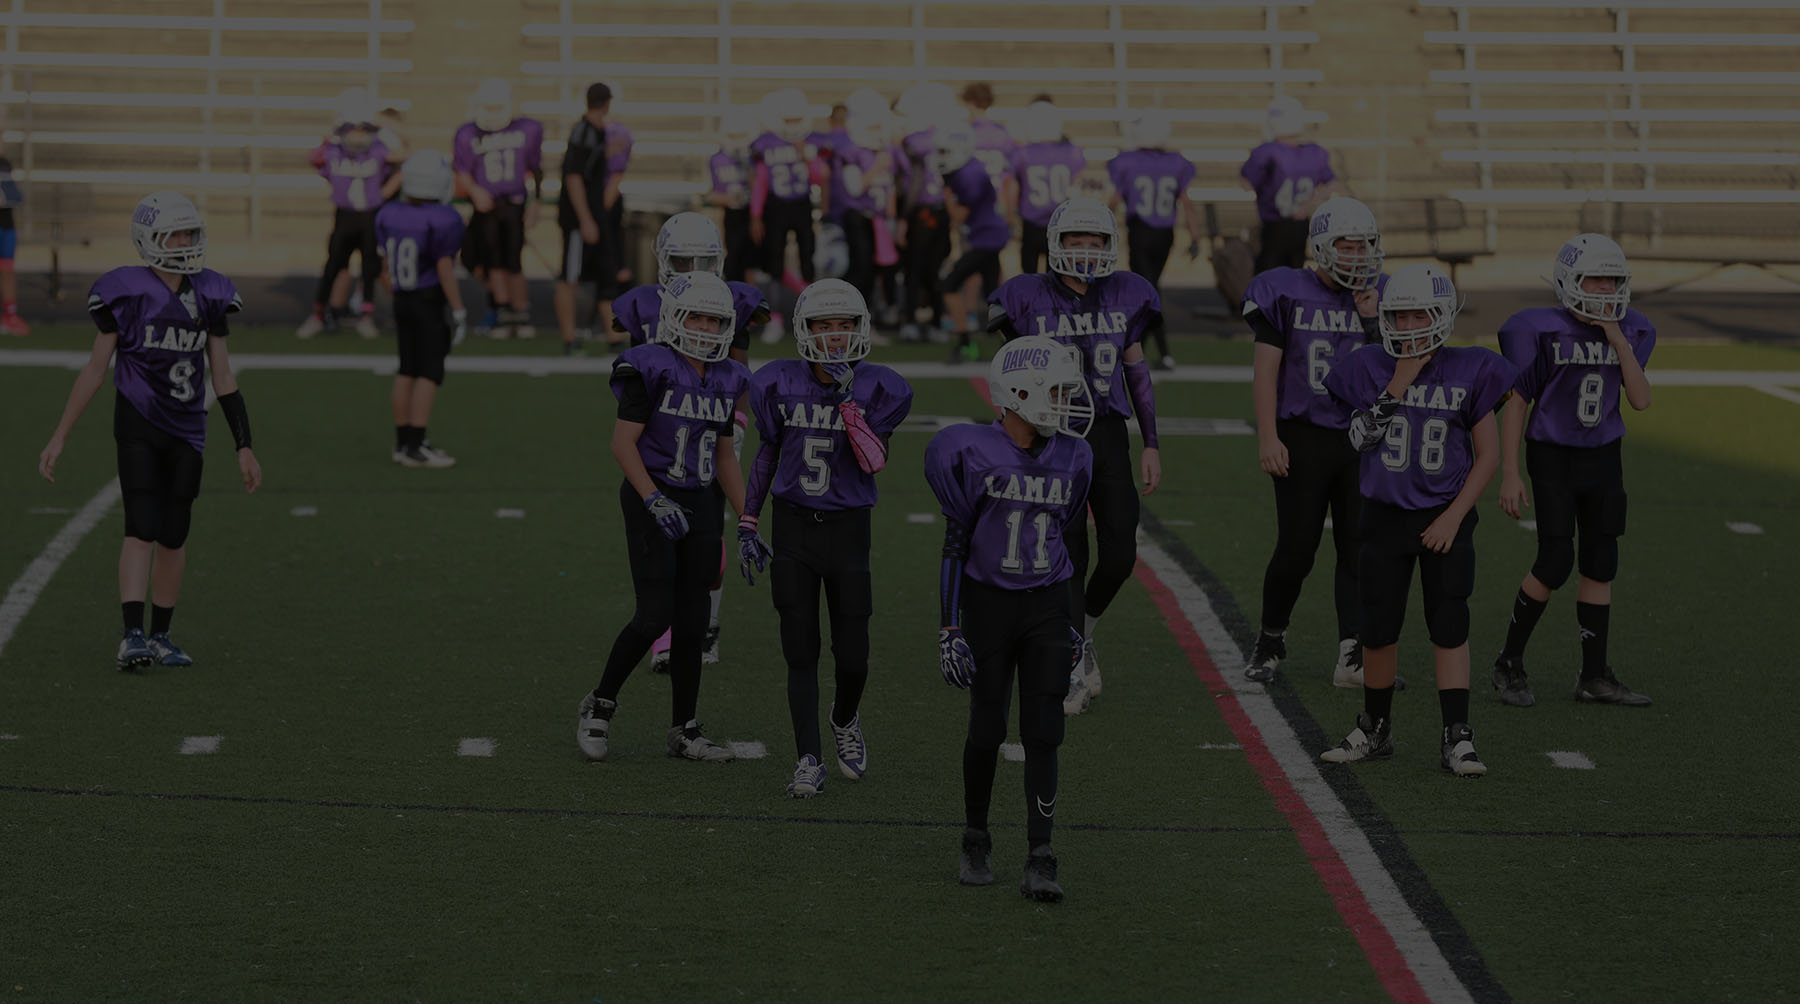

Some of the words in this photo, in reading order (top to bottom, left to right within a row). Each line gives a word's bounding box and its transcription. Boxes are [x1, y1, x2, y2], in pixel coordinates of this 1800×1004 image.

[1026, 163, 1072, 207] 50
[1133, 175, 1179, 217] 36
[386, 236, 419, 291] 18
[143, 325, 207, 352] LAMA
[1036, 311, 1128, 338] LAMAR
[1293, 306, 1365, 333] LAMA
[1002, 348, 1051, 375] DAWGS
[1552, 341, 1633, 365] LAMA
[168, 359, 197, 402] 9
[1400, 384, 1468, 411] MAR
[1577, 373, 1605, 428] 8
[778, 402, 866, 431] LAMA
[665, 425, 717, 486] 16
[1380, 414, 1449, 475] 98
[799, 435, 835, 497] 5
[1000, 509, 1052, 575] 11
